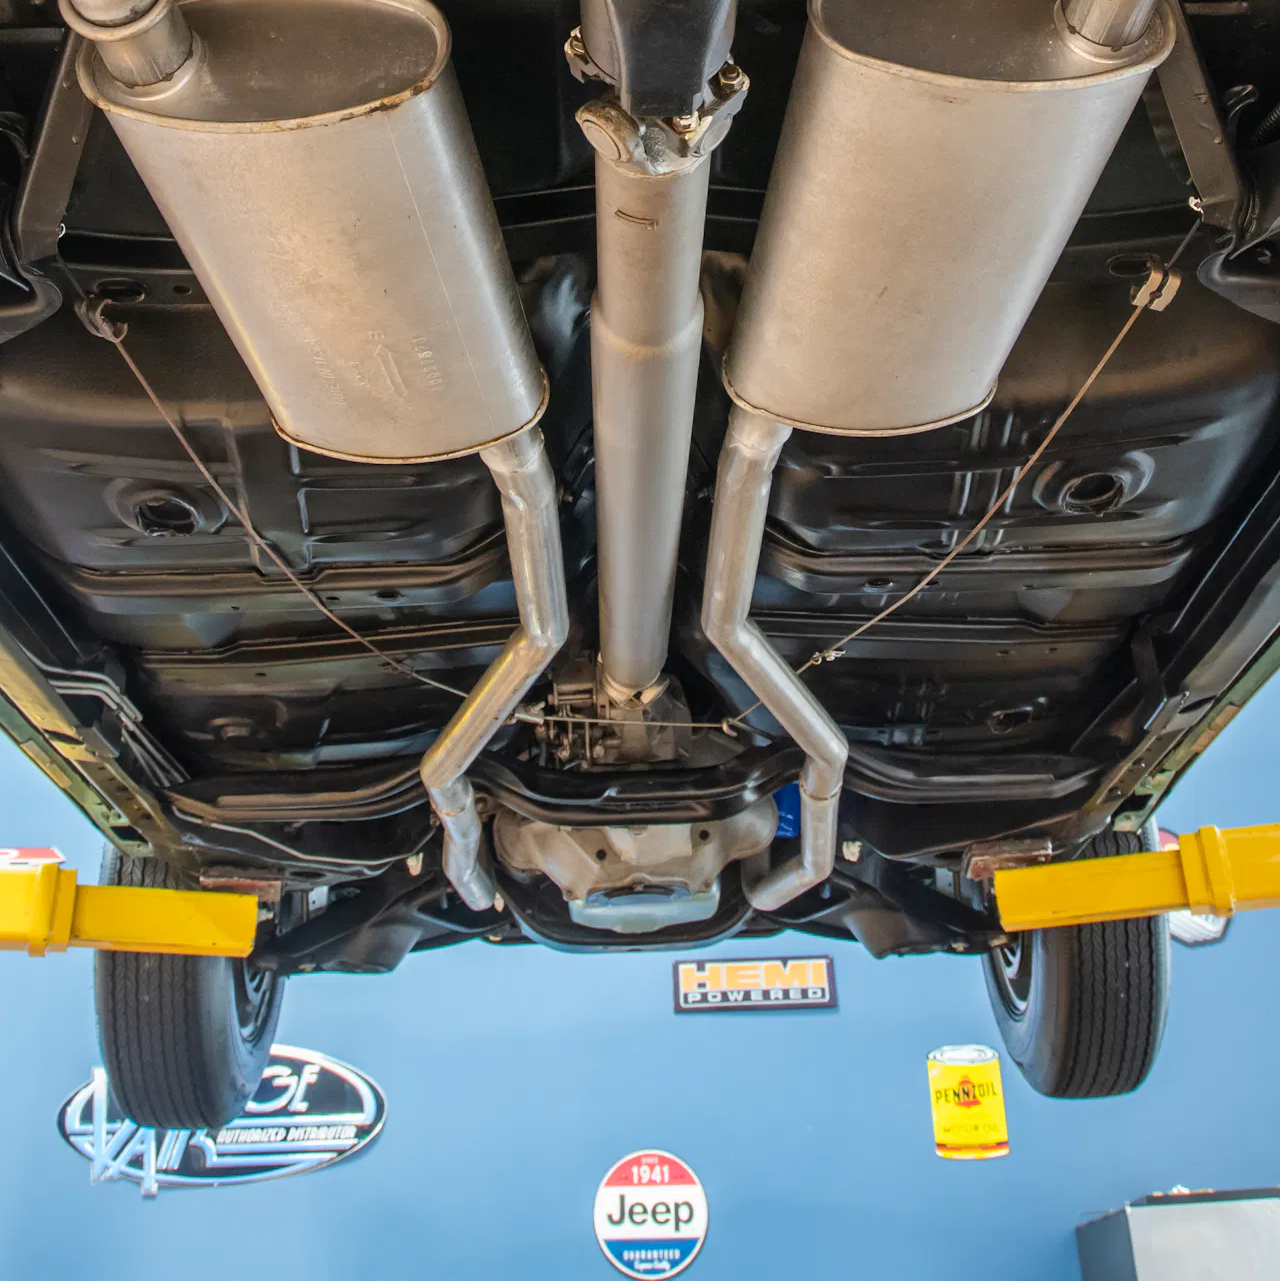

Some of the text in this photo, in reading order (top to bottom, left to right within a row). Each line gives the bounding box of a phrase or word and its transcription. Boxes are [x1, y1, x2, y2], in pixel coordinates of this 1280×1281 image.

[680, 960, 826, 991] HEMI
[687, 989, 822, 1004] POWERED
[935, 1081, 998, 1104] PENNZOIL
[631, 1164, 670, 1184] 1941
[606, 1193, 694, 1232] Jeep
